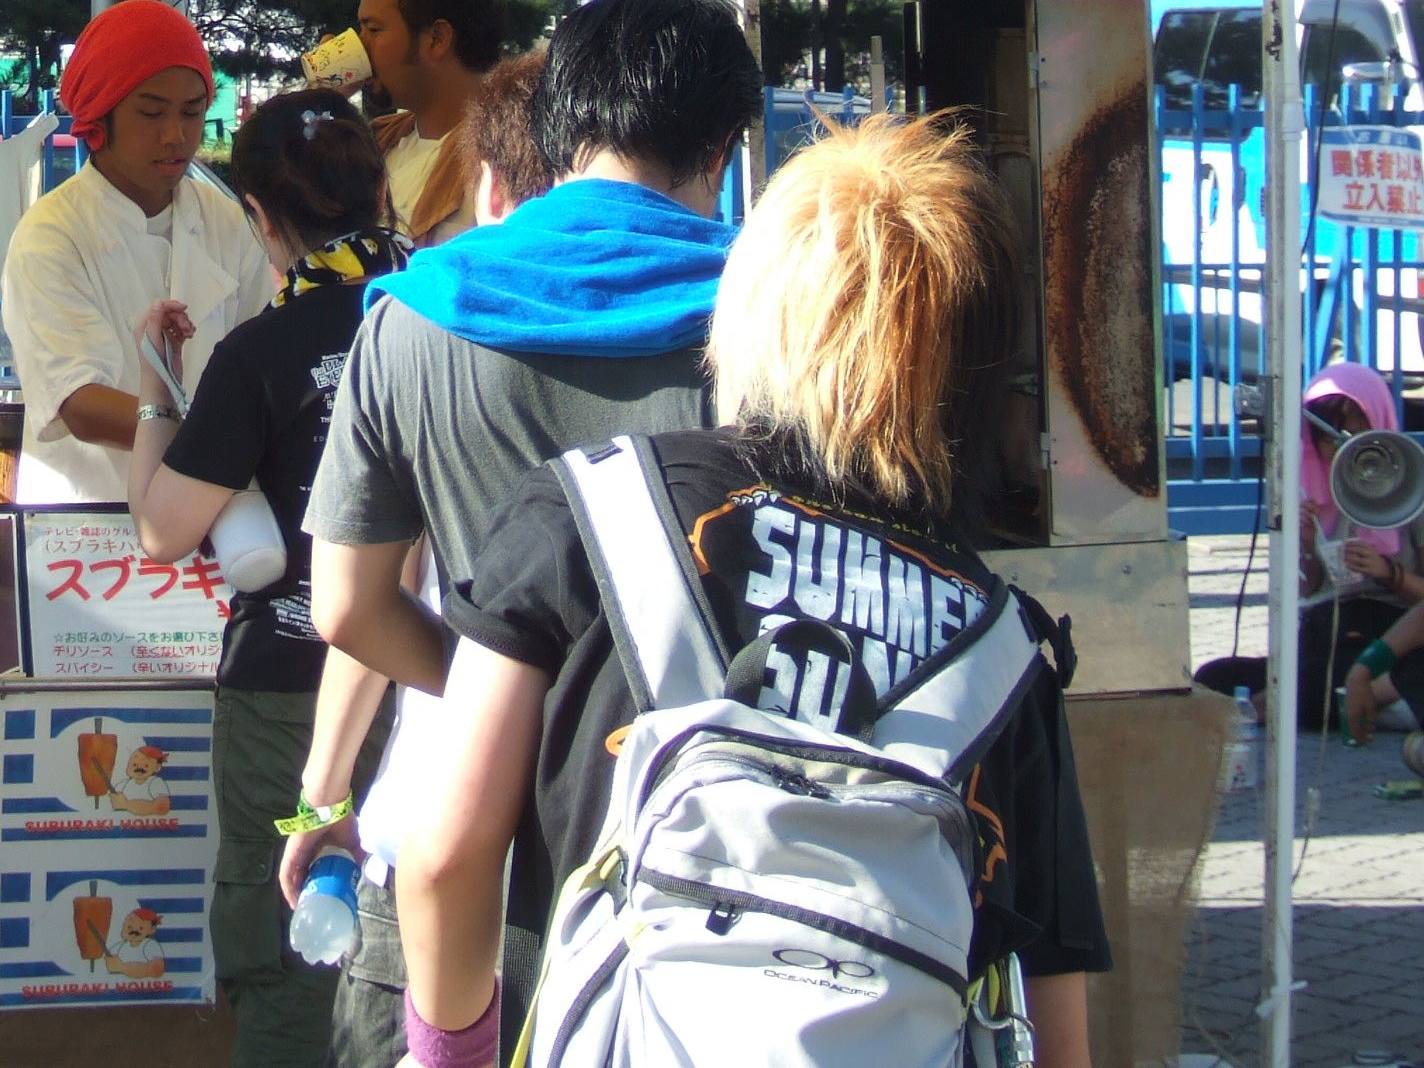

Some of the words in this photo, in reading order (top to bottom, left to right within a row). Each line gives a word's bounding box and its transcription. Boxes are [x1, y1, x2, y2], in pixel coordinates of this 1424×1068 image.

[46, 554, 225, 601] スブラキ
[54, 646, 113, 656] チリソース
[763, 969, 817, 985] OCEAN
[819, 979, 878, 999] PACIFIC
